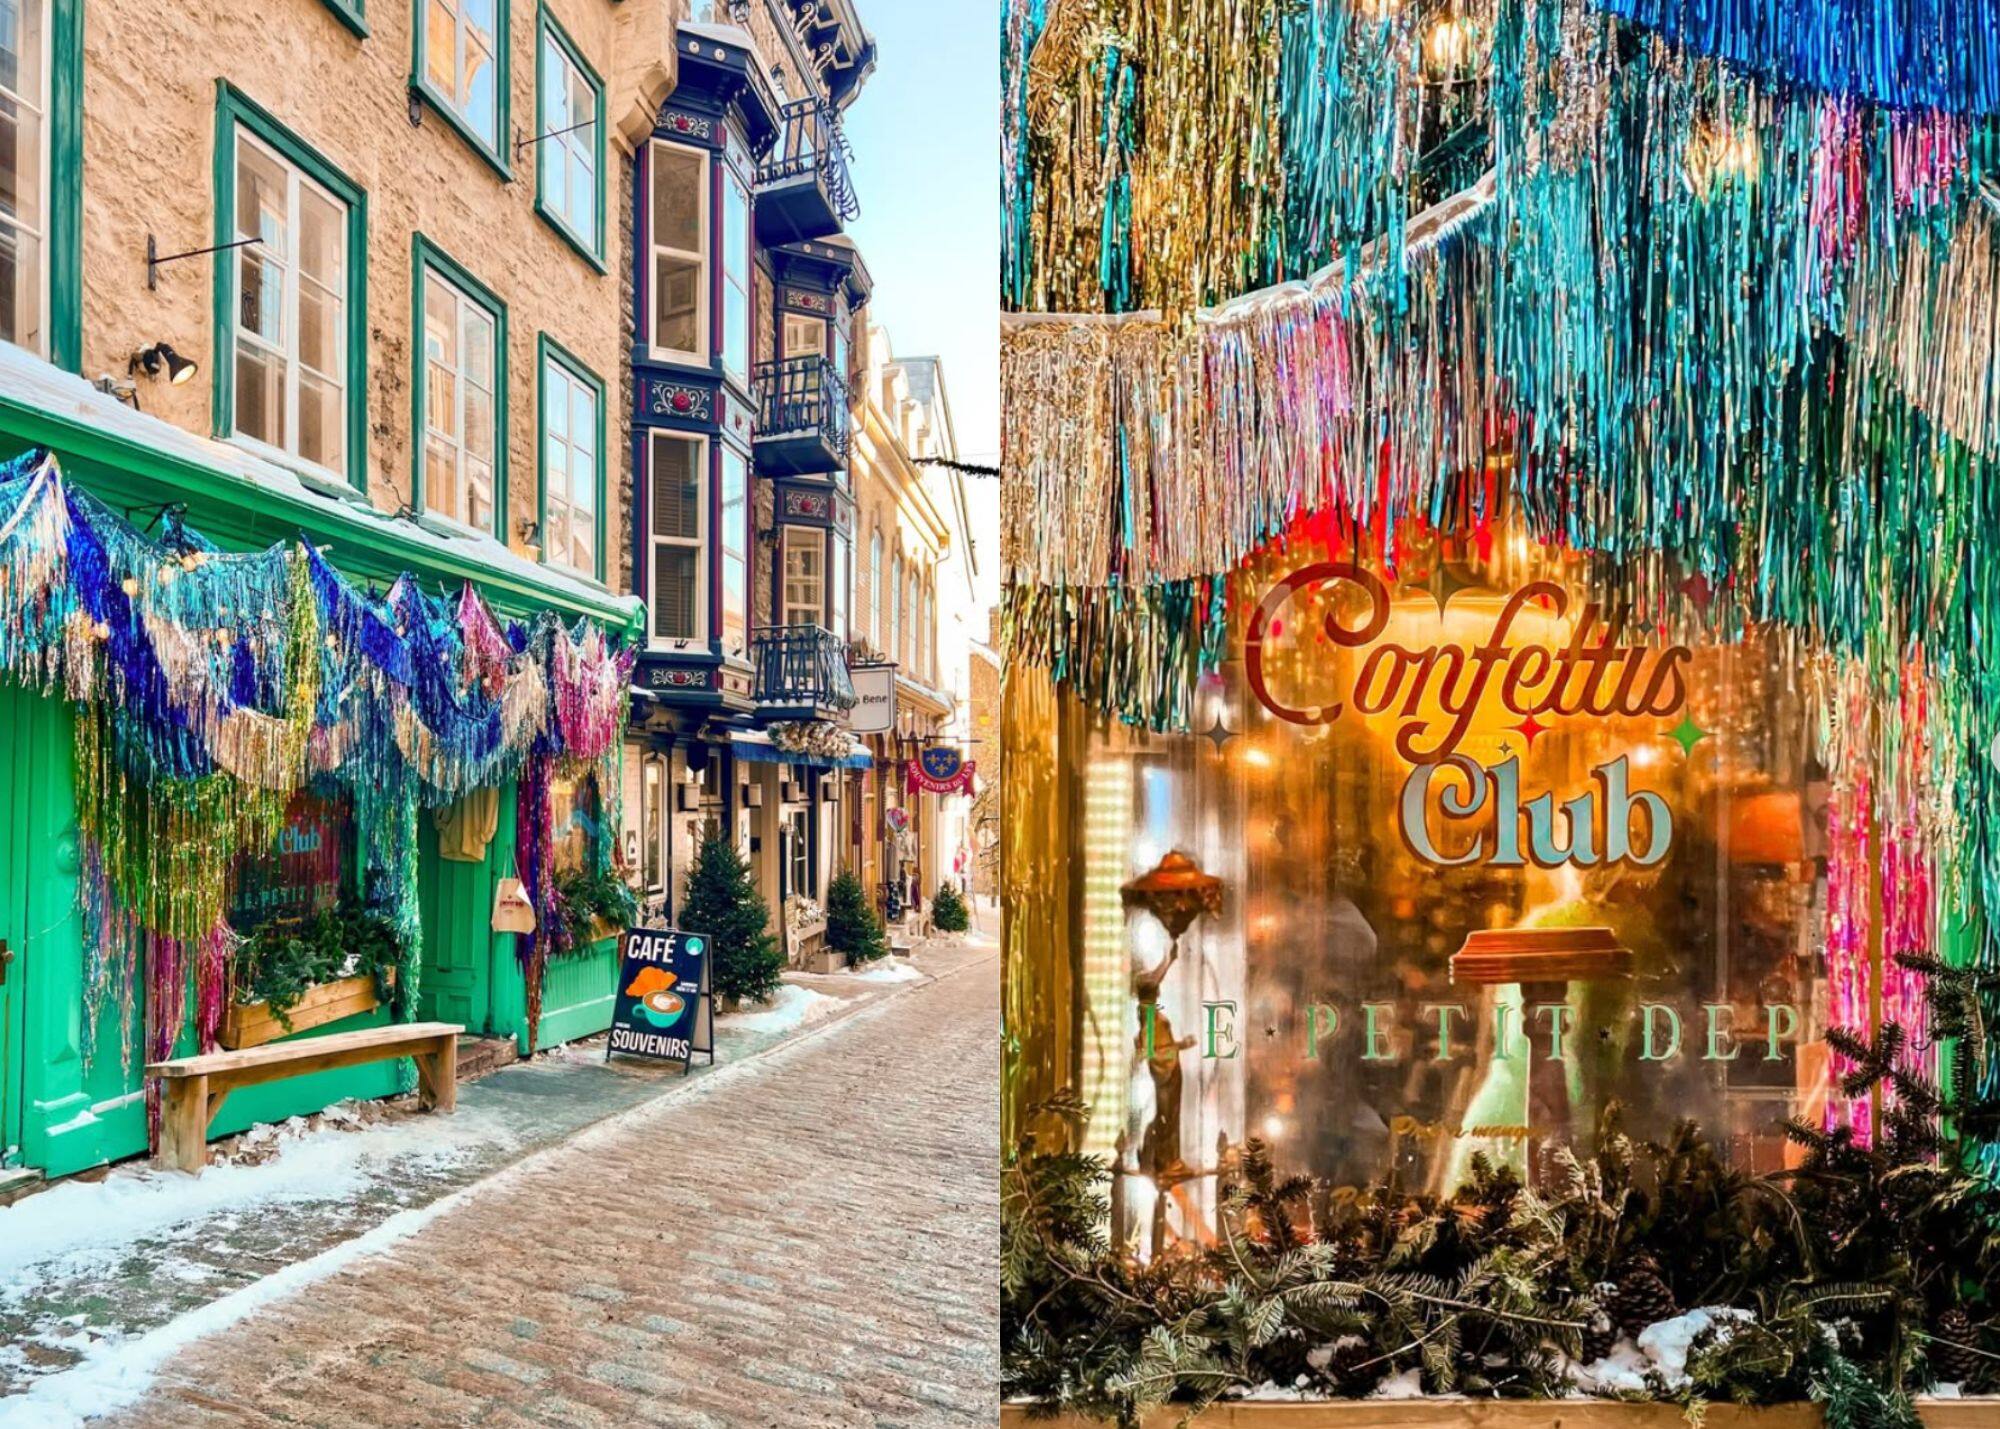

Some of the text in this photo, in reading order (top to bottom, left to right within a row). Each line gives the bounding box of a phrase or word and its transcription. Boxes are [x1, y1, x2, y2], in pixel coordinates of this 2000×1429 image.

[1244, 562, 1693, 765] Confettis
[863, 694, 887, 704] Bene
[909, 761, 952, 790] SOUVENIRS
[1399, 753, 1673, 869] Club
[279, 824, 321, 853] Club
[627, 935, 676, 963] CAFÉ
[611, 1029, 690, 1059] SOUVENIRS
[1305, 1001, 1575, 1061] PETIT
[1639, 1002, 1800, 1061] DEP
